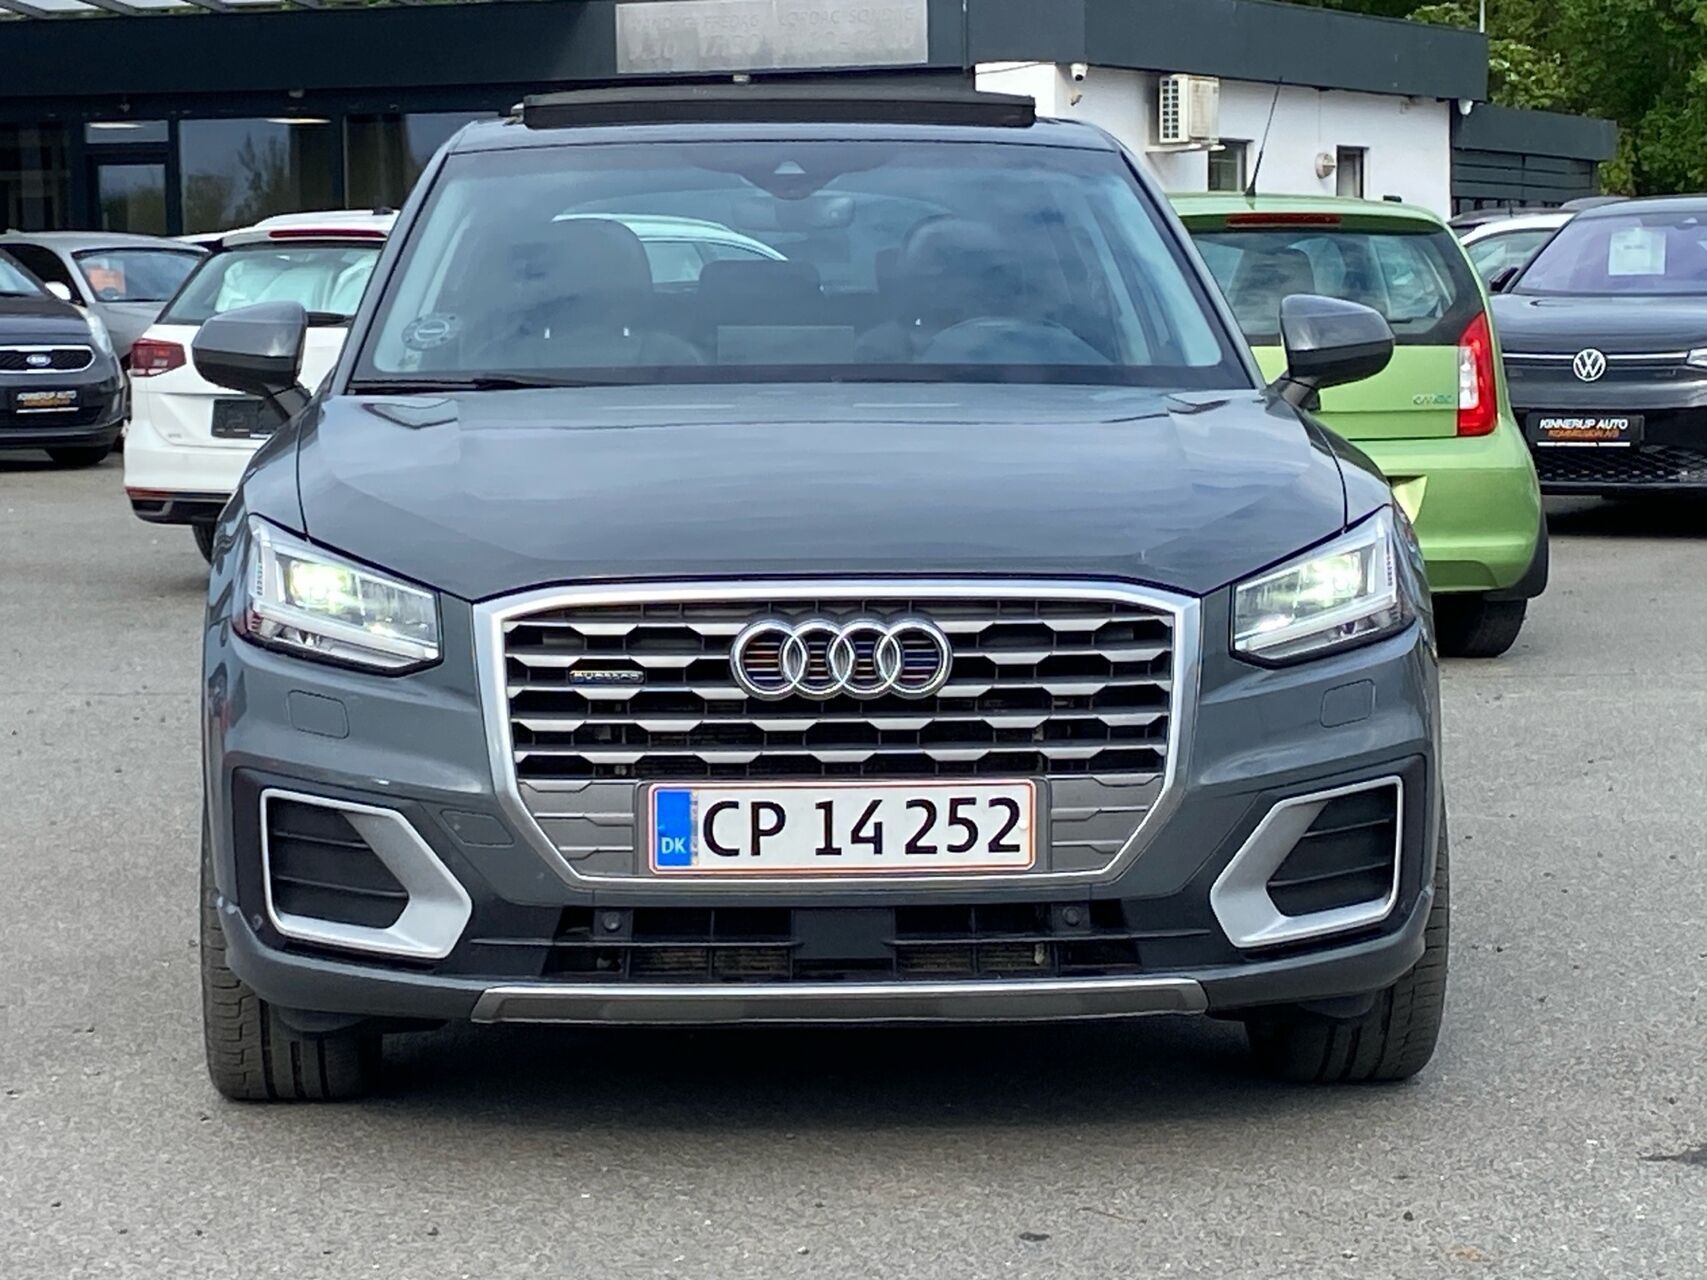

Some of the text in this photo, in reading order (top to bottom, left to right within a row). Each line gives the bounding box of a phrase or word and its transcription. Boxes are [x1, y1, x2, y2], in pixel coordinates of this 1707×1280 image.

[1539, 418, 1628, 430] KINNERUP AUTO
[703, 797, 1021, 857] CP 14 252
[661, 836, 687, 855] DK
